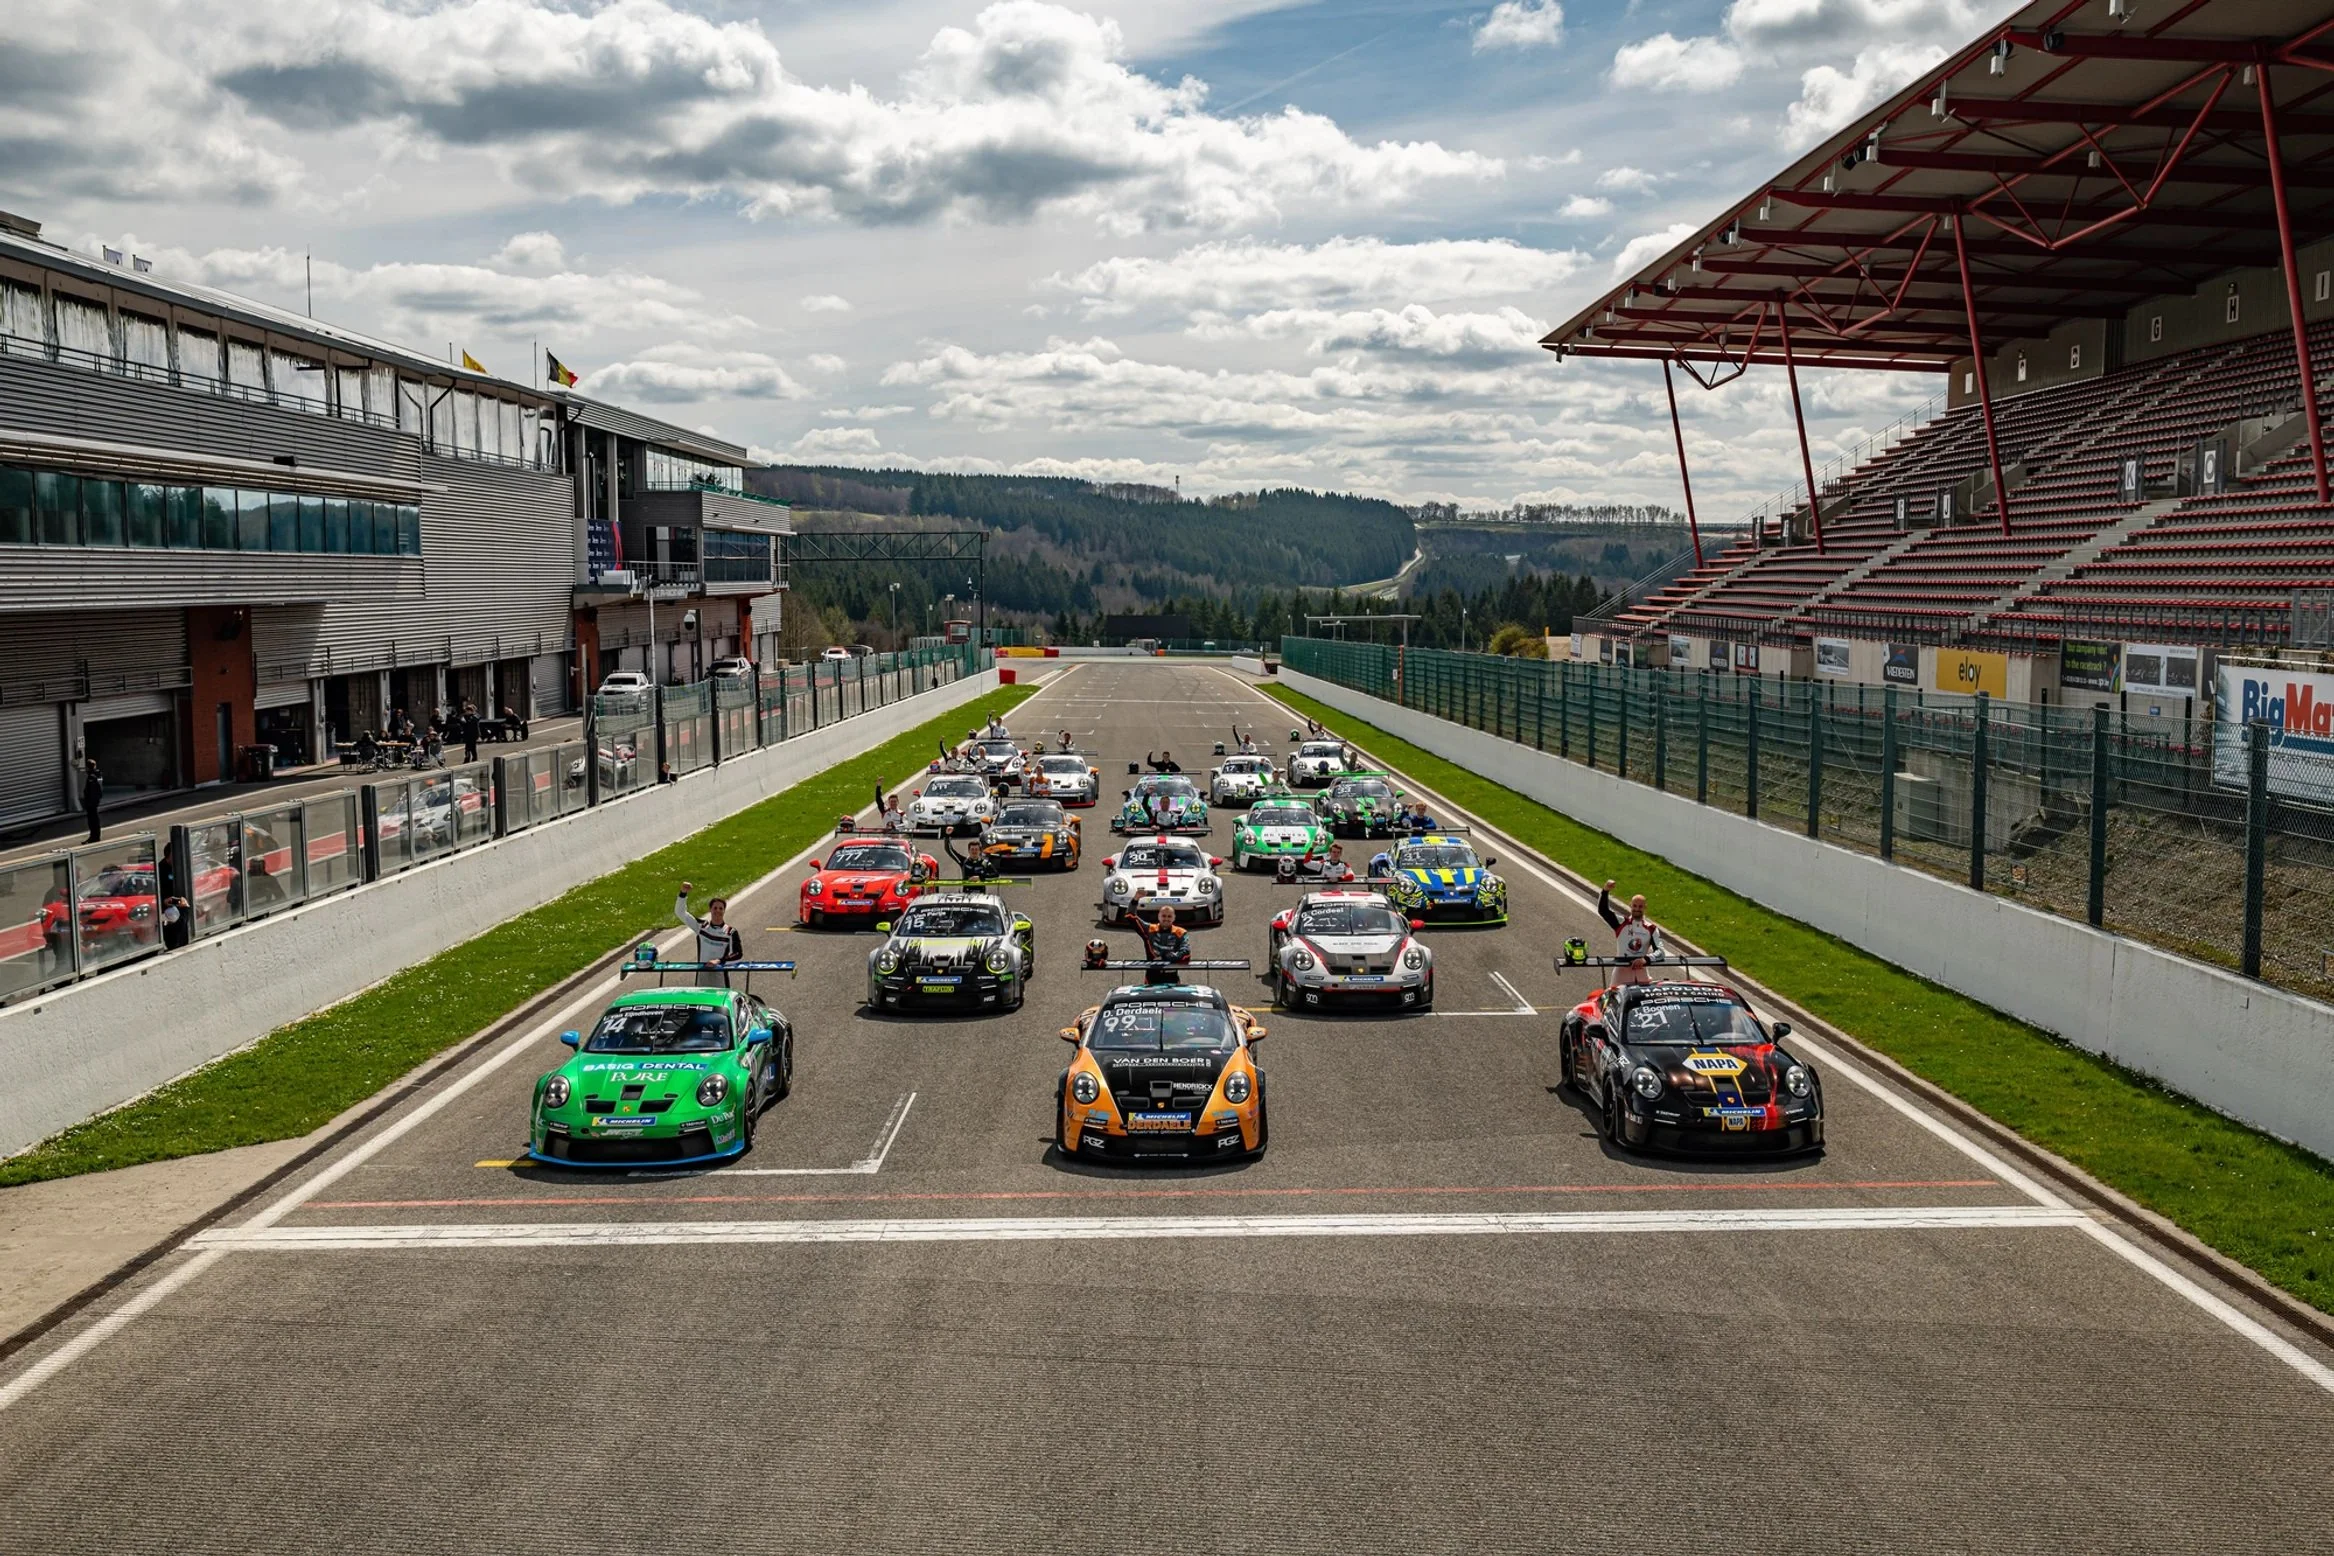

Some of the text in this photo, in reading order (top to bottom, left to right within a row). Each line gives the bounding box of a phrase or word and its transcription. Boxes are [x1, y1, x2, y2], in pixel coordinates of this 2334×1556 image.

[2229, 297, 2237, 321] H
[2153, 318, 2161, 339] G
[2126, 464, 2135, 488] K
[1958, 656, 1982, 690] eloy
[2241, 679, 2334, 747] BigMa
[836, 852, 863, 863] 777
[1129, 852, 1147, 863] 30
[904, 917, 925, 930] 15
[1303, 916, 1314, 928] 2
[1640, 986, 1724, 994] NAPOLEON
[1113, 1001, 1214, 1010] PORSCHE
[1640, 997, 1733, 1006] PORSCHE
[619, 1003, 714, 1013] PORSCHE
[1102, 1010, 1114, 1018] D.
[1642, 1004, 1681, 1013] Boonen
[603, 1017, 628, 1034] 14
[1104, 1014, 1137, 1032] 99
[1638, 1010, 1668, 1029] 21
[641, 1062, 706, 1070] DENTAL
[1692, 1058, 1739, 1070] NAPA
[1127, 1120, 1192, 1130] DERDAELE
[1728, 1117, 1745, 1127] NAPA
[1083, 1135, 1105, 1149] PGZ
[1217, 1134, 1240, 1149] PGZ
